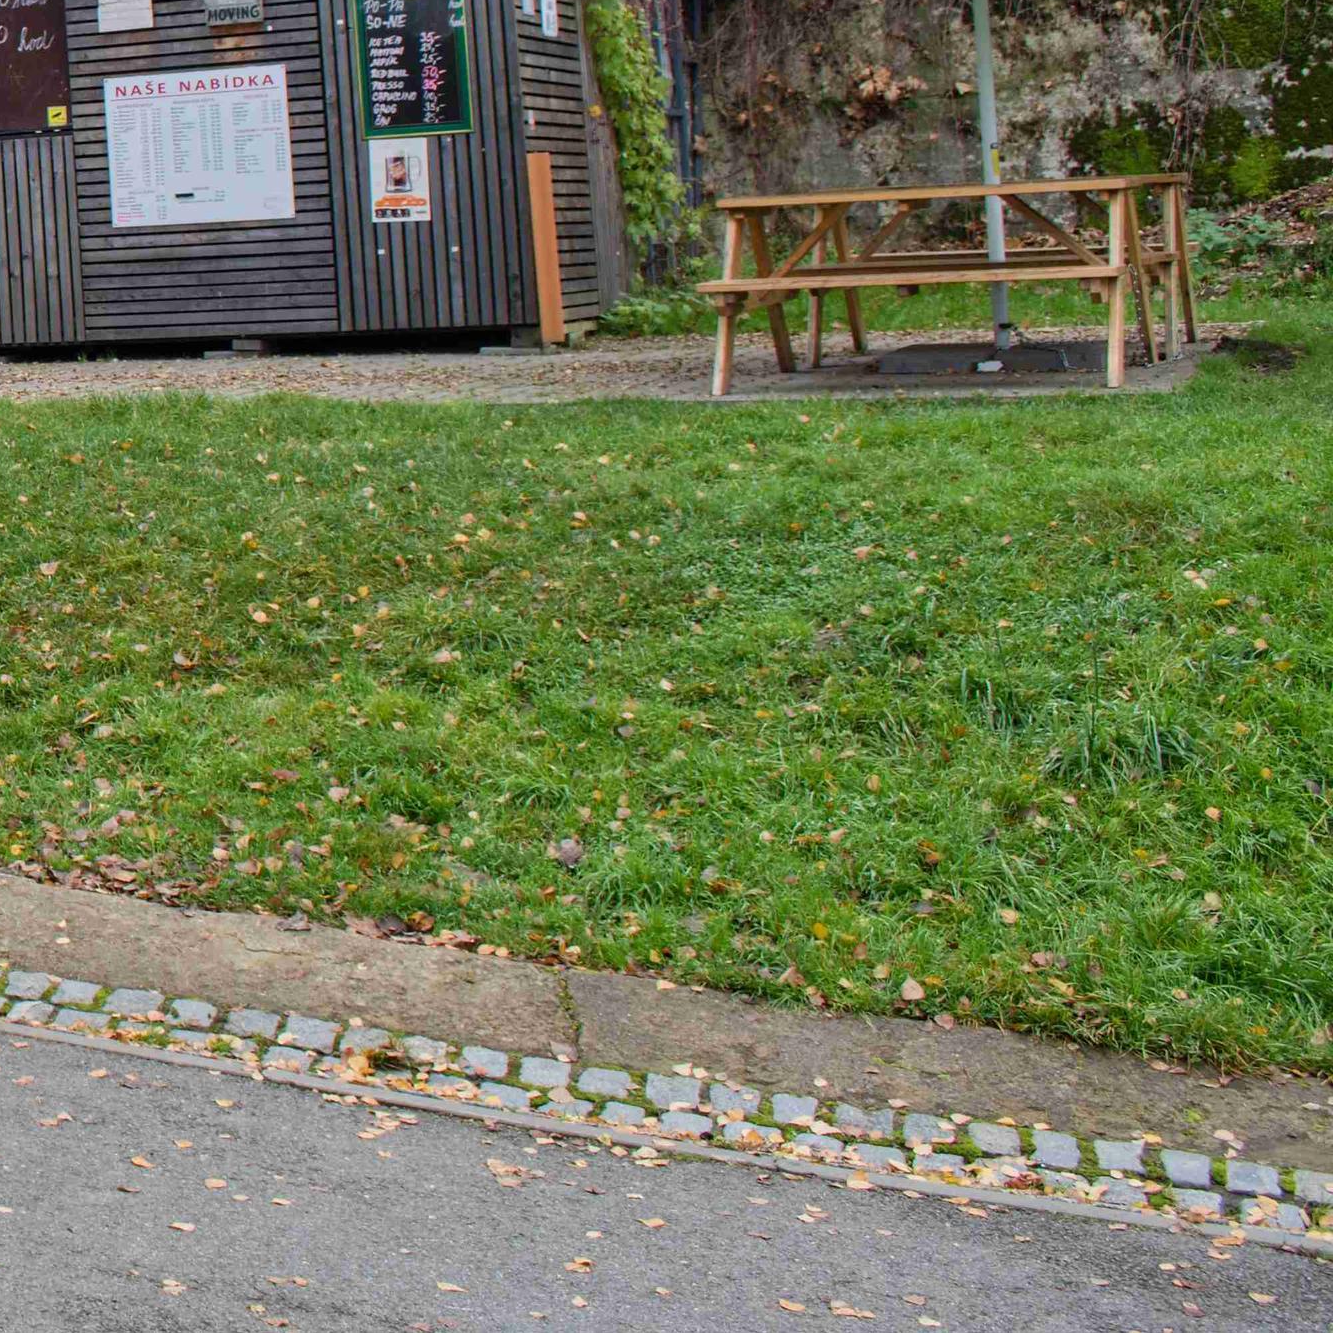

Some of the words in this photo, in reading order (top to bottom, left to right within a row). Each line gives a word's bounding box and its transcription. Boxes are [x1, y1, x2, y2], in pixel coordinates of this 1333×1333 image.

[207, 5, 261, 22] MOVING
[115, 80, 166, 98] NAŠE
[179, 74, 274, 93] NABÍDKA
[373, 103, 398, 114] GROG
